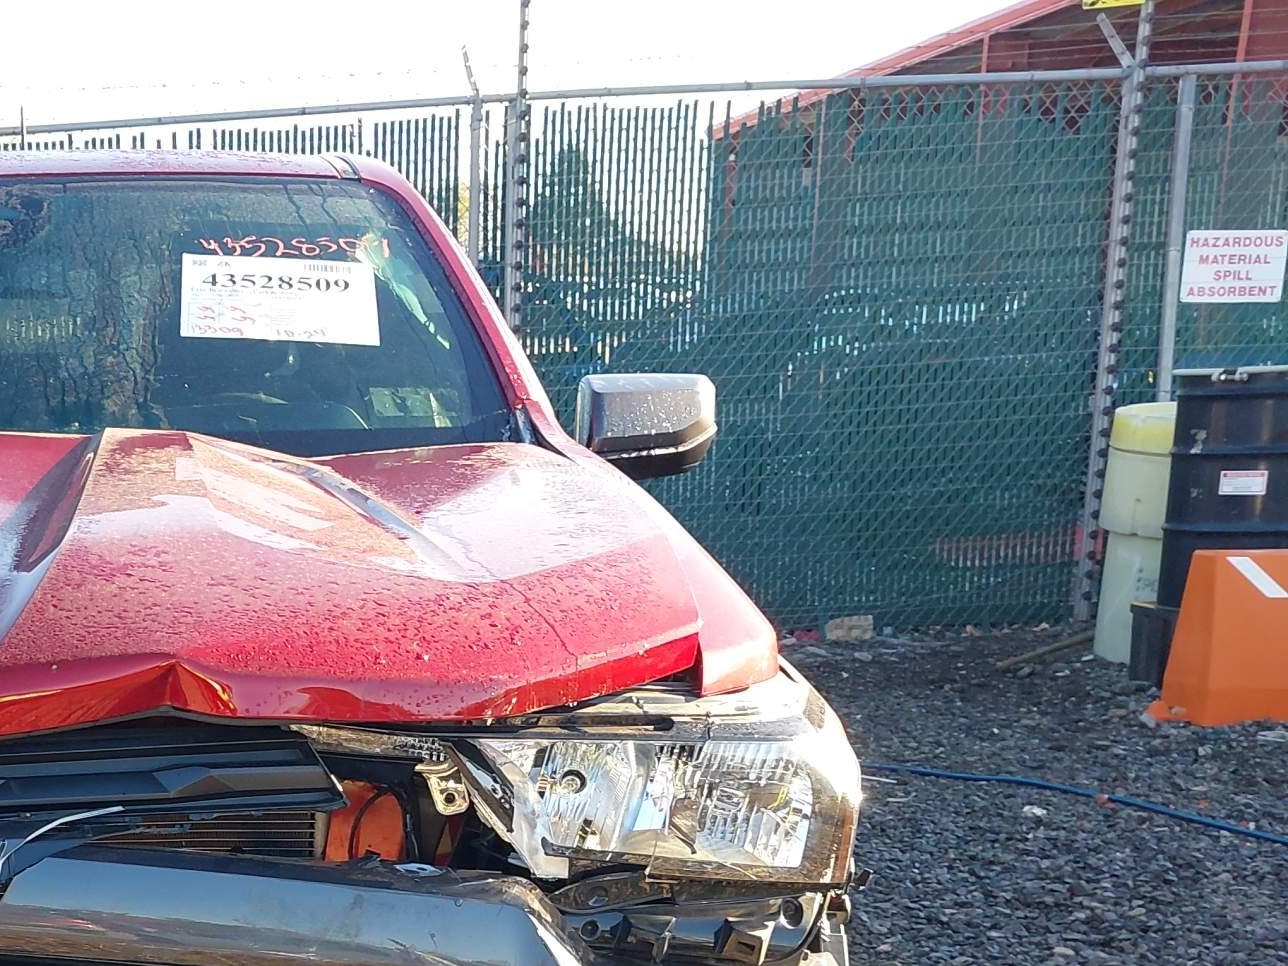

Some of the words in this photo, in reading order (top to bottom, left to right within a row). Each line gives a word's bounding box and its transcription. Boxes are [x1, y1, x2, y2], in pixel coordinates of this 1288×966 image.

[1190, 235, 1284, 248] HAZARDOUS
[1198, 253, 1271, 265] MATERIAL
[1213, 270, 1253, 281] SPILL
[202, 272, 350, 293] 43528509
[1186, 285, 1277, 297] ABSORBENT
